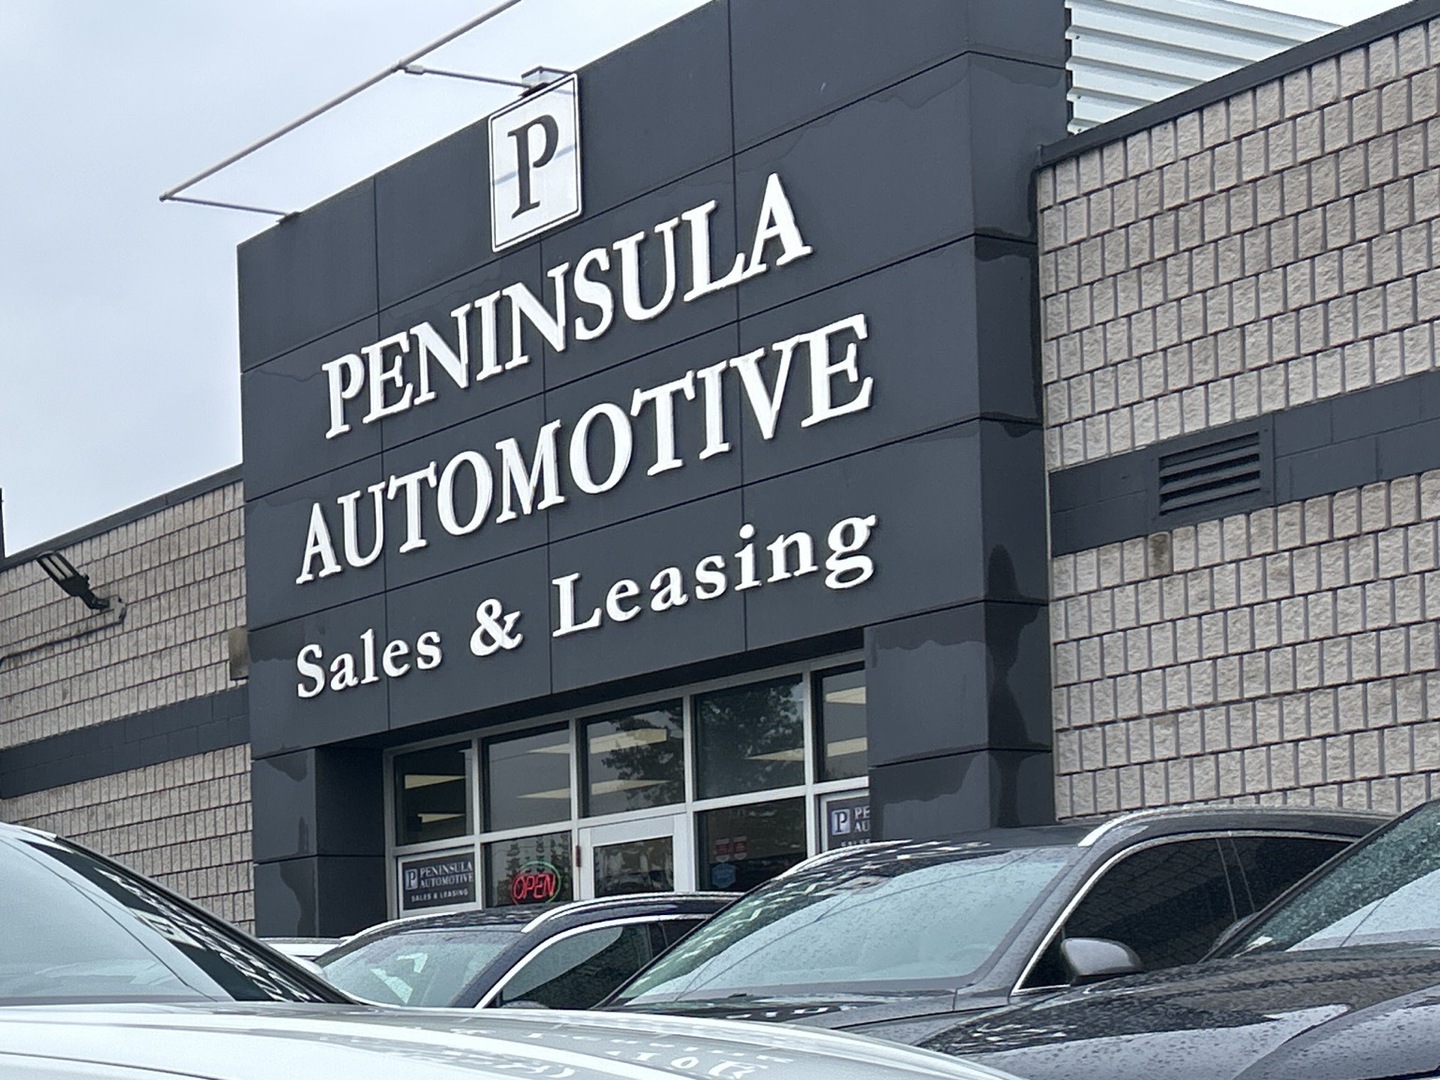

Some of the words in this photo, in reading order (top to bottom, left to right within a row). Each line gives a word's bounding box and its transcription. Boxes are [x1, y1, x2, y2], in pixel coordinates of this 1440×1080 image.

[507, 114, 559, 219] P
[322, 172, 813, 440] PENINSULA
[295, 314, 874, 586] AUTOMOTIVE
[296, 628, 443, 700] Sales
[469, 598, 523, 657] &
[551, 514, 878, 639] Leasing
[419, 861, 473, 878] PENINSULA
[420, 873, 474, 889] AUTOMOTIVE
[439, 888, 469, 899] LEASING
[513, 873, 556, 900] OPEN
